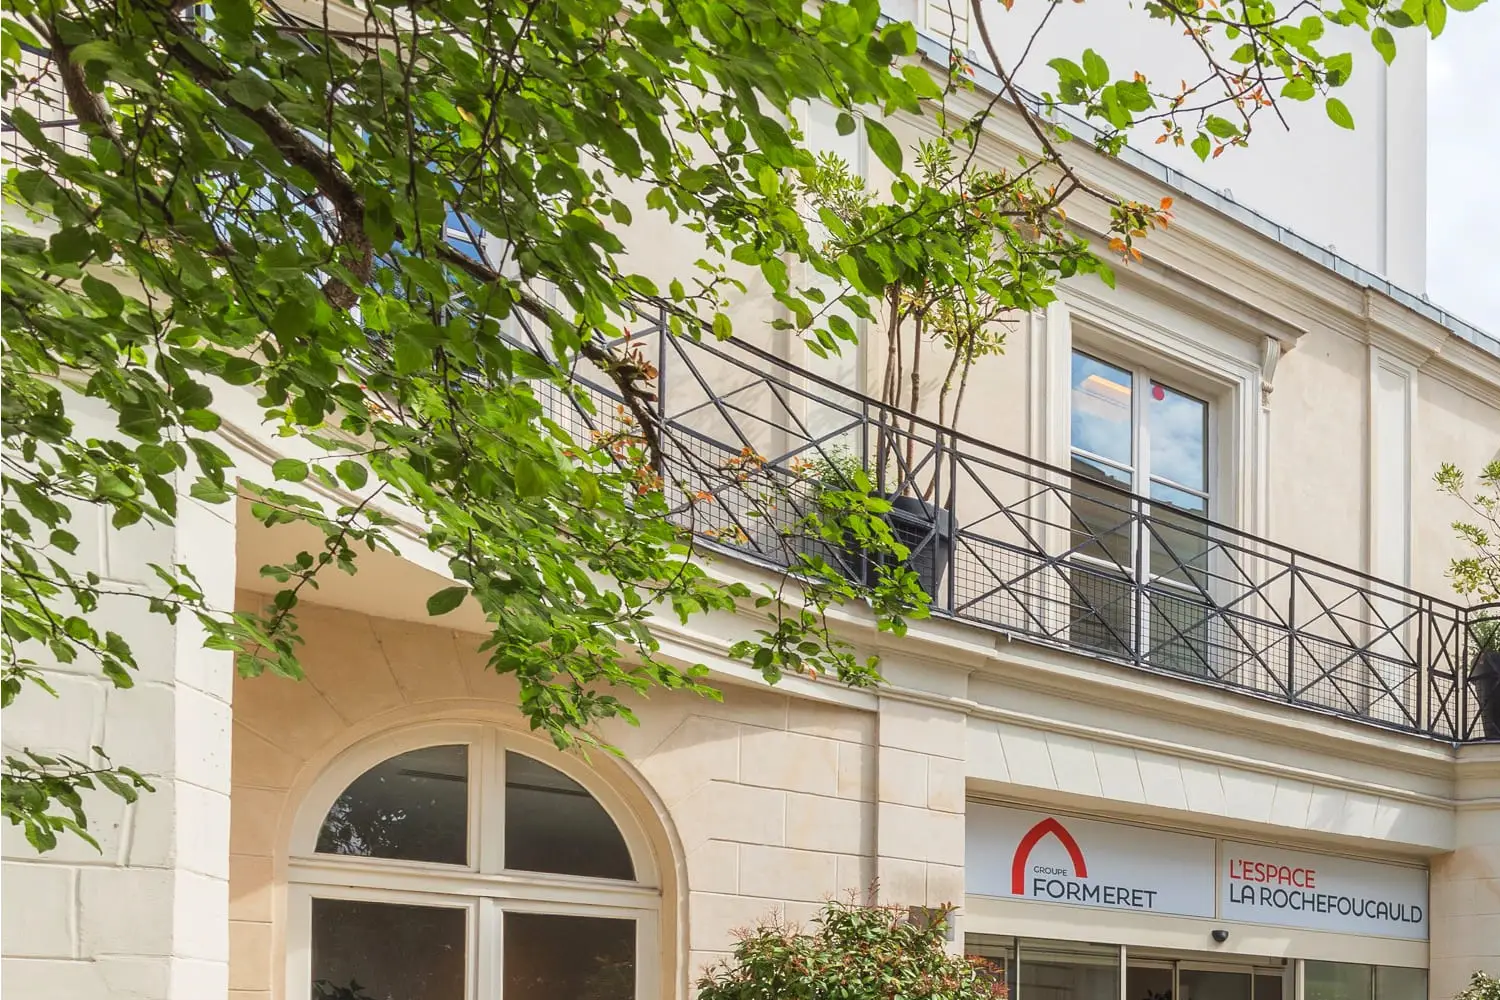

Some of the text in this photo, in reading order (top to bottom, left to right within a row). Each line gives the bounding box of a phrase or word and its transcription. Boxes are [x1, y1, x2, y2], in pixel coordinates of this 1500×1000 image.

[1033, 865, 1068, 877] GROUPE
[1230, 859, 1316, 889] L'ESPACE
[1033, 878, 1157, 908] FORMERET
[1230, 883, 1423, 923] LA ROCHEFOUCAULD
